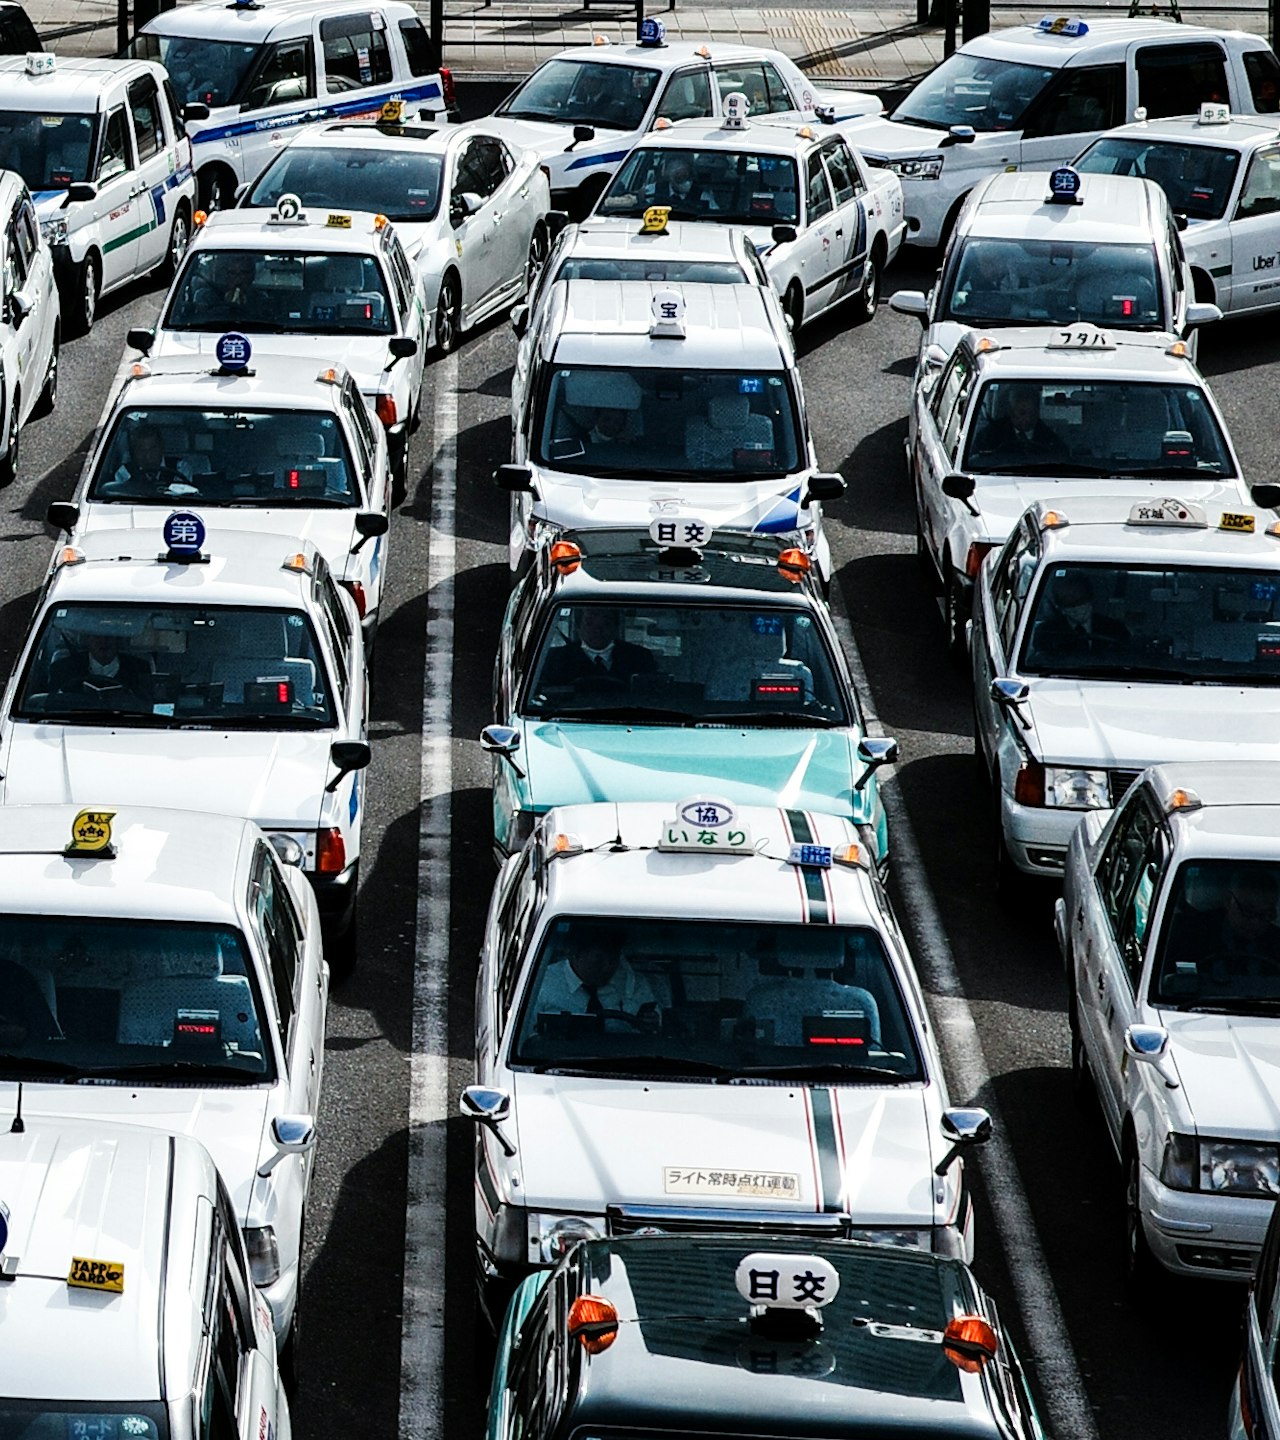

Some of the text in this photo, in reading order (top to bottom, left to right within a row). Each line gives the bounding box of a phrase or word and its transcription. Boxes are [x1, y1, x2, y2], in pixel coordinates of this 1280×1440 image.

[1203, 108, 1228, 120] 中央
[1252, 254, 1275, 272] Uber
[660, 302, 677, 319] 宝
[1060, 332, 1108, 346] フタバ
[1139, 507, 1164, 521] 宮城
[658, 523, 704, 542] 日交
[694, 805, 719, 823] 協
[667, 829, 747, 847] いなり
[668, 1168, 797, 1193] ライト常時点灯運動
[72, 1260, 107, 1275] TAPP
[71, 1270, 105, 1285] CARD
[748, 1269, 826, 1303] 日交
[73, 1419, 112, 1435] カード
